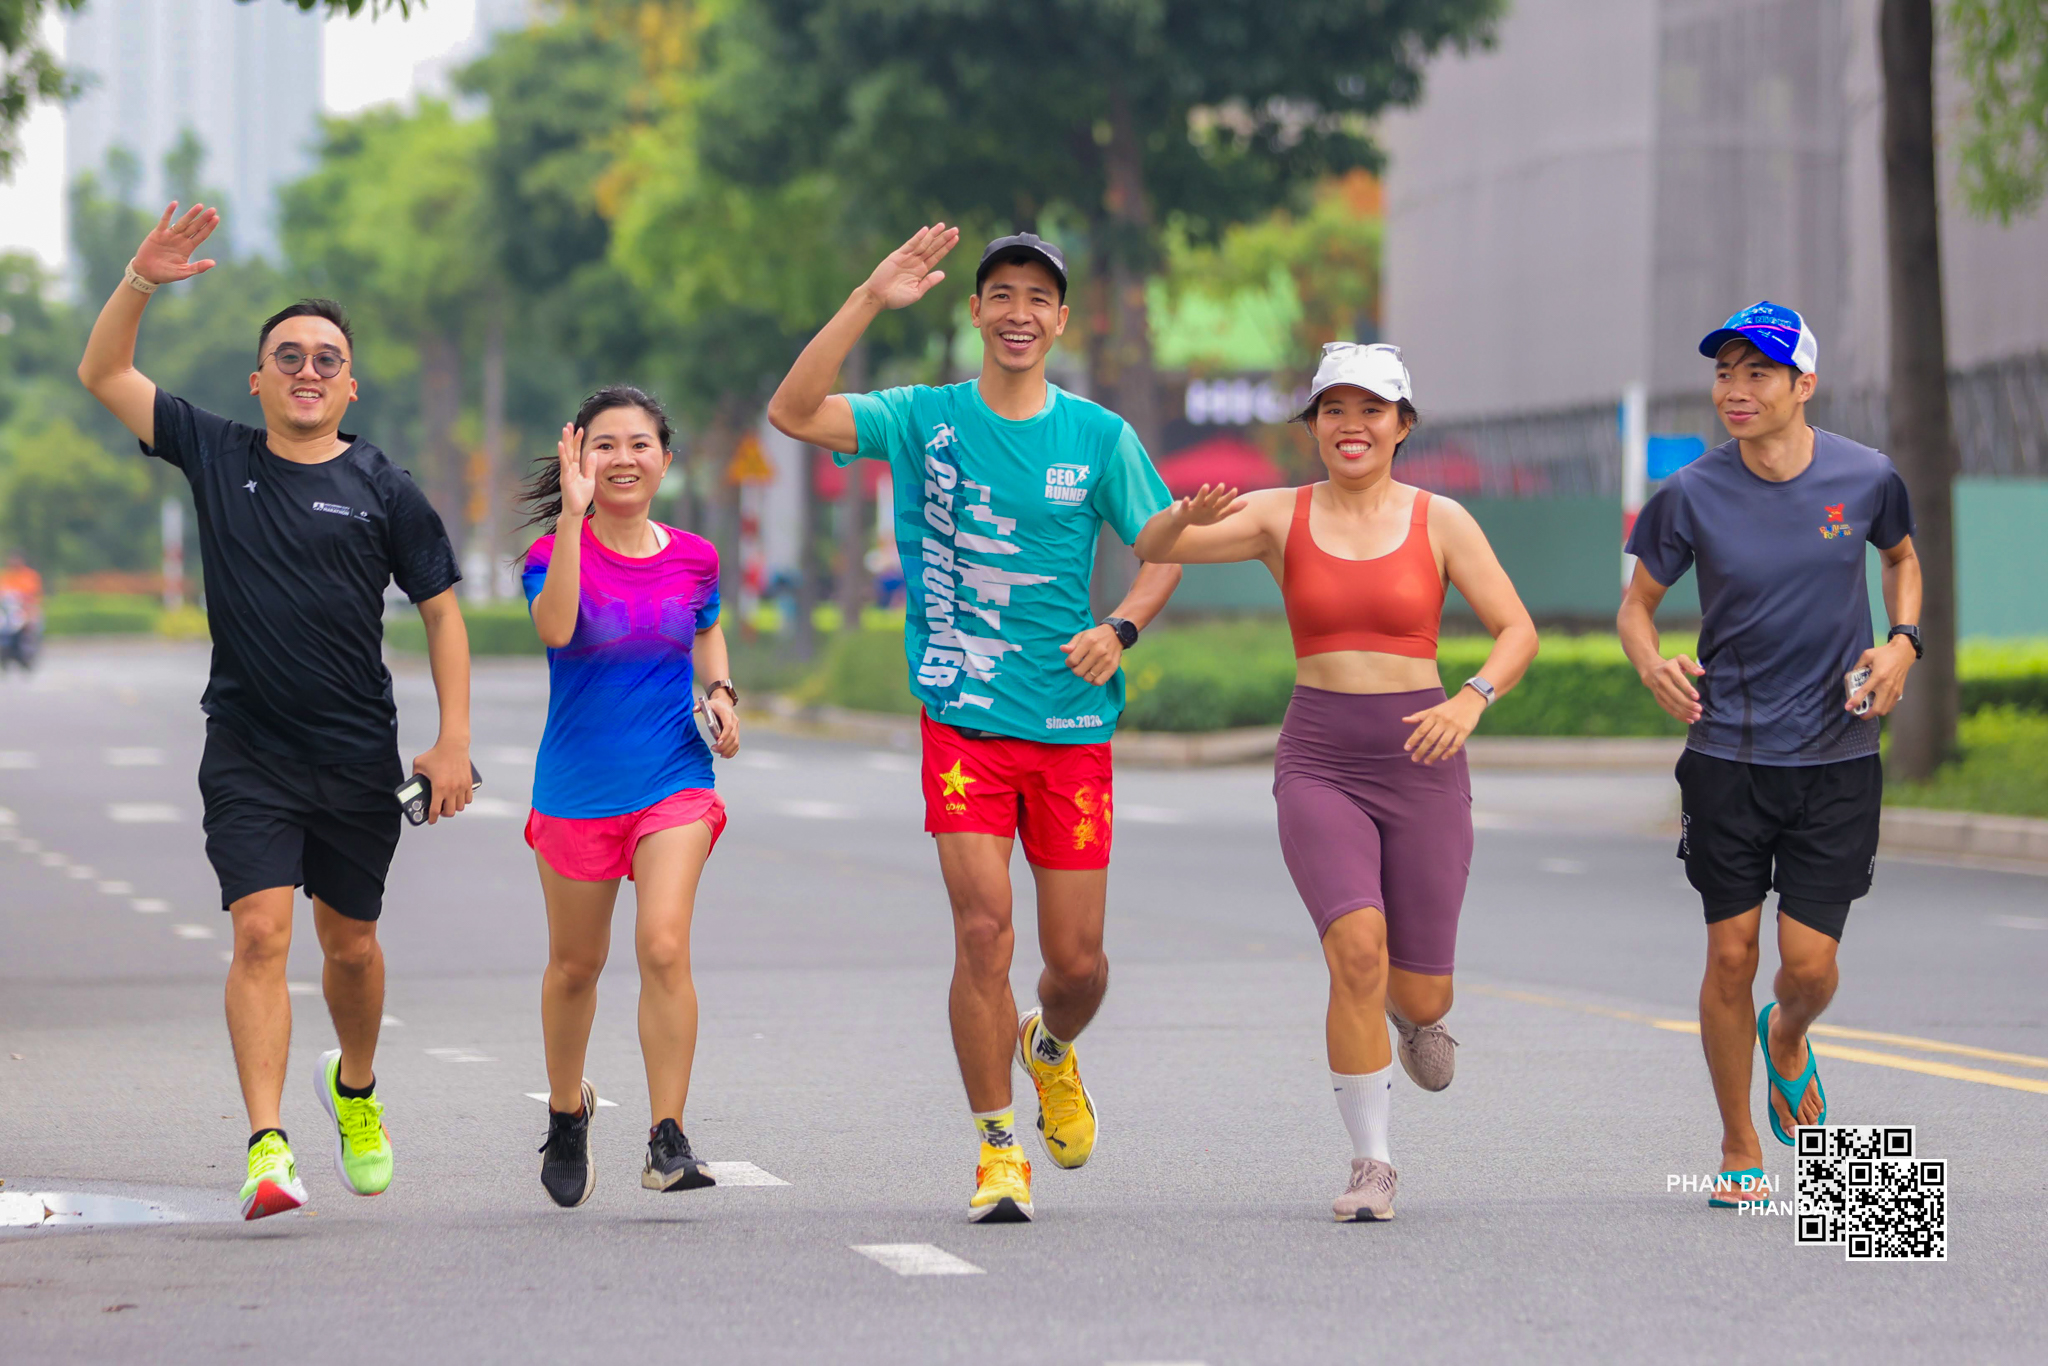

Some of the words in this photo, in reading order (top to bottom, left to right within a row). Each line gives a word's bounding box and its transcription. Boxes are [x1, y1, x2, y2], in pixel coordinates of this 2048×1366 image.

[923, 454, 957, 536] CEO
[1045, 485, 1088, 501] RUNNER
[1046, 468, 1074, 486] CEO
[917, 536, 966, 687] RUNNER
